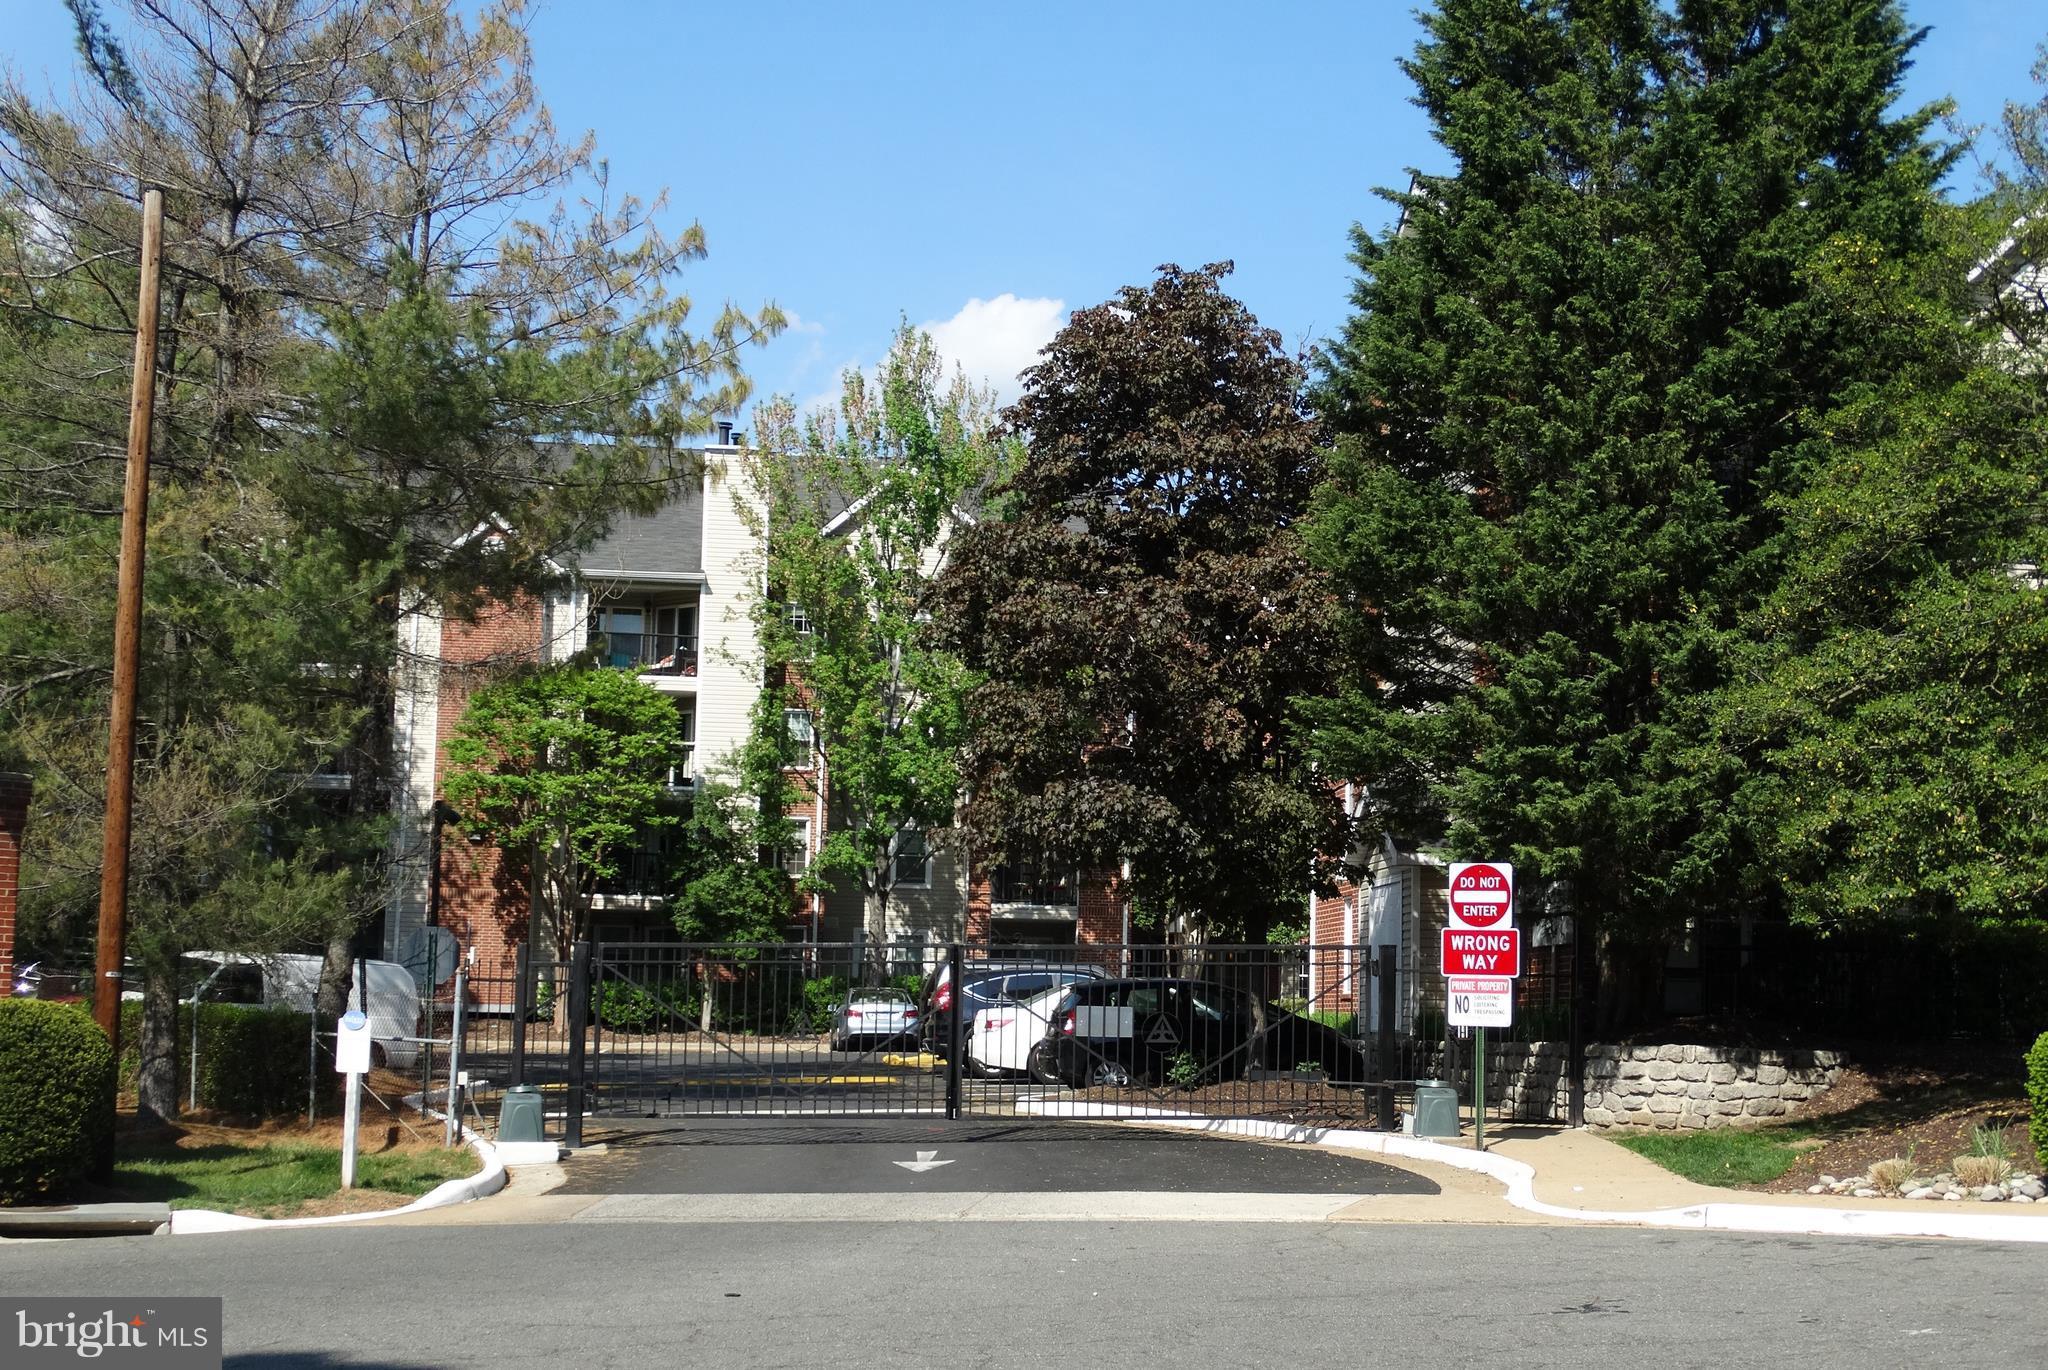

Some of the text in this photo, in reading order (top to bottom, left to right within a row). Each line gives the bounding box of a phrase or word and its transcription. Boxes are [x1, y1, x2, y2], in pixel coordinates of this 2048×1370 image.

[1460, 877, 1501, 888] DO NOT
[1463, 905, 1497, 916] ENTER
[1451, 935, 1510, 951] WRONG
[1462, 954, 1498, 970] WAY
[1452, 980, 1508, 992] PRIVATE PROPERTY
[1455, 995, 1470, 1014] NO
